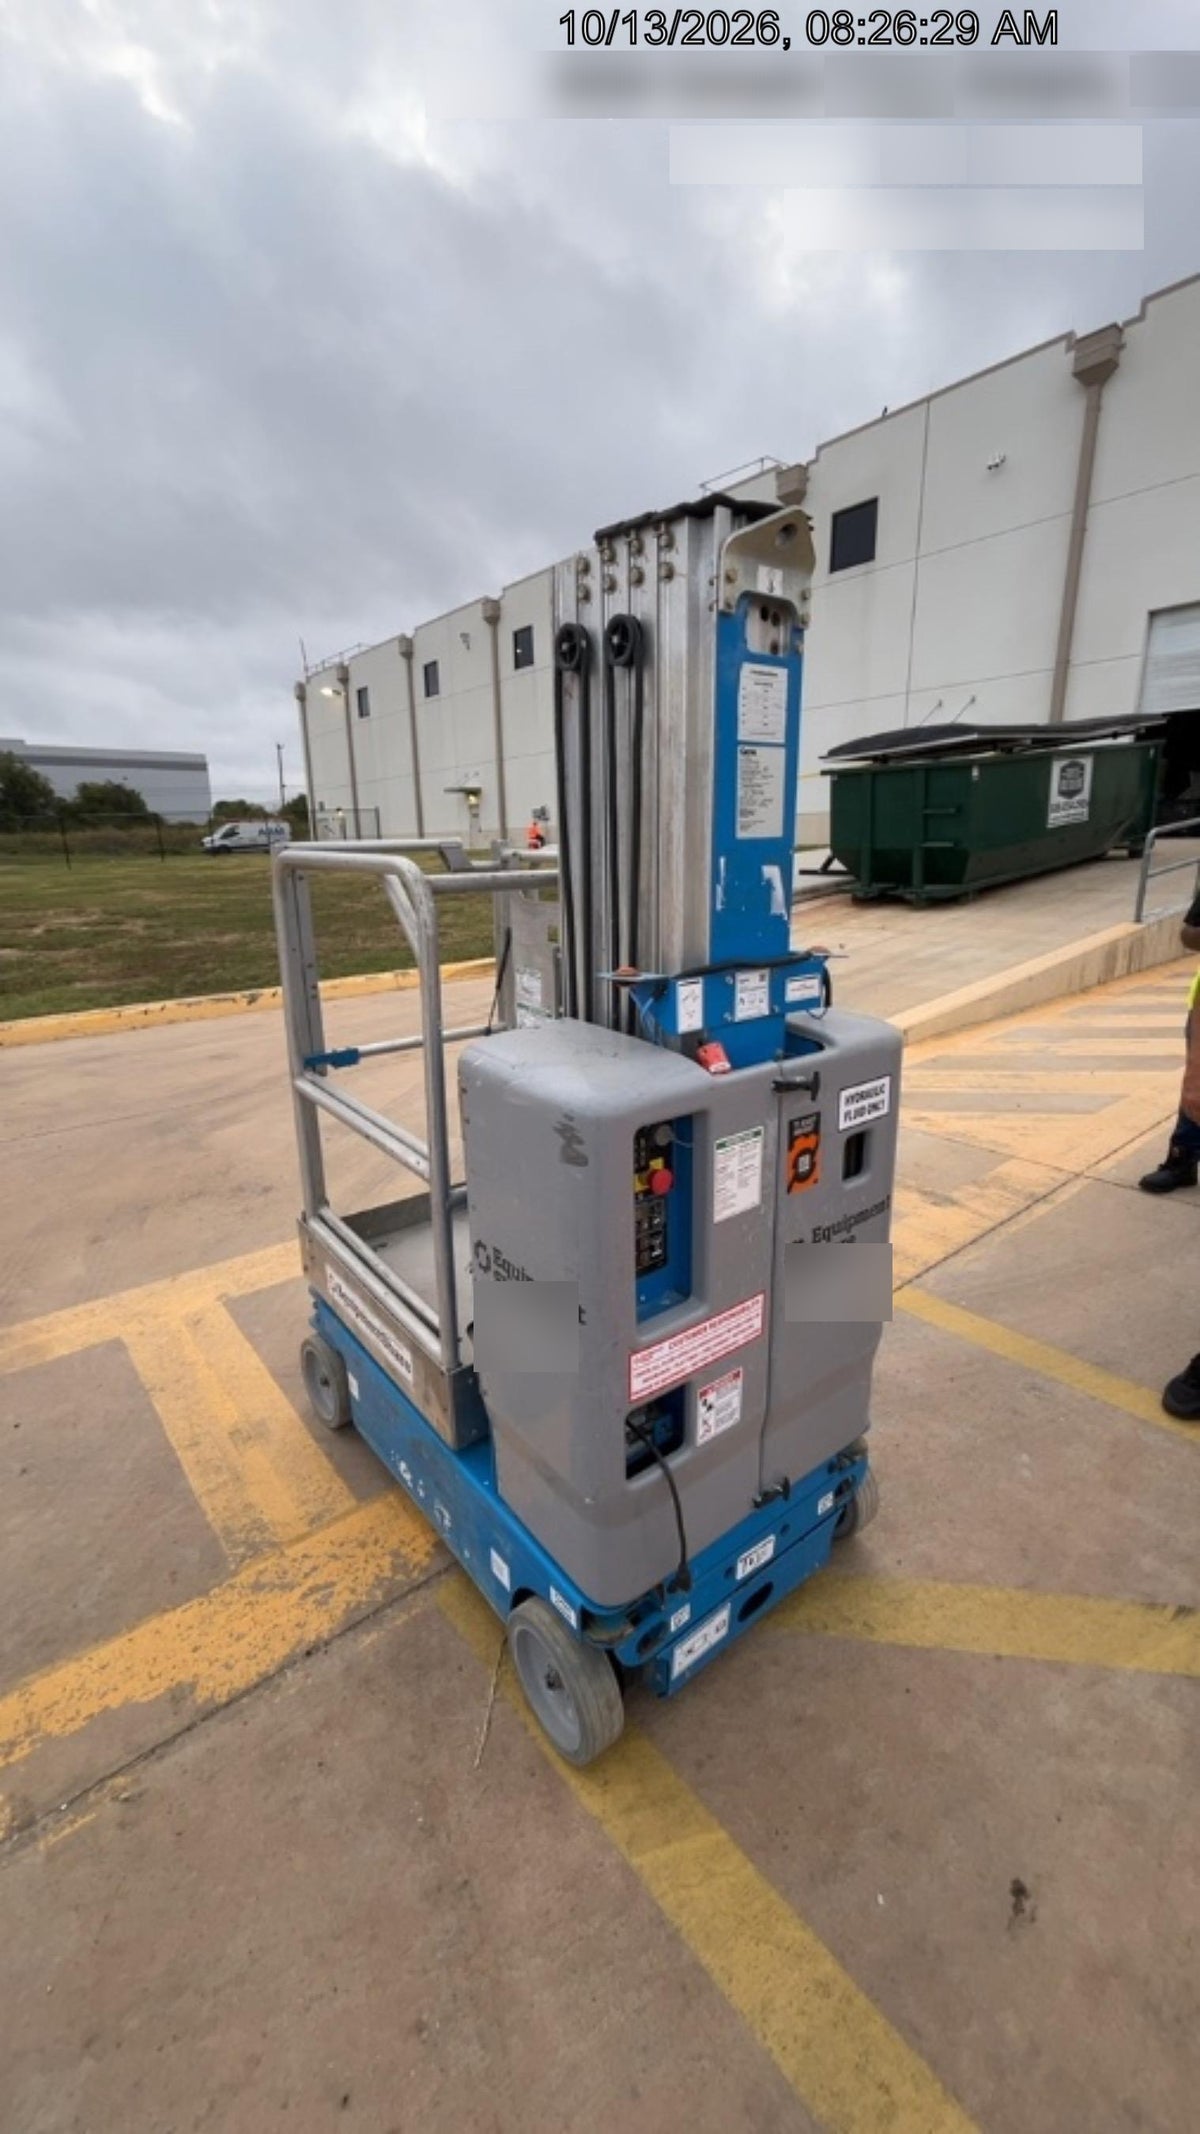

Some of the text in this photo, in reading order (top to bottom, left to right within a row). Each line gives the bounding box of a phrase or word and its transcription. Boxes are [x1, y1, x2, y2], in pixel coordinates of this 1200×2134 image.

[844, 1082, 885, 1107] HYDRAULIC
[844, 1099, 885, 1123] FLUID ONLY
[811, 1194, 891, 1244] Equipment
